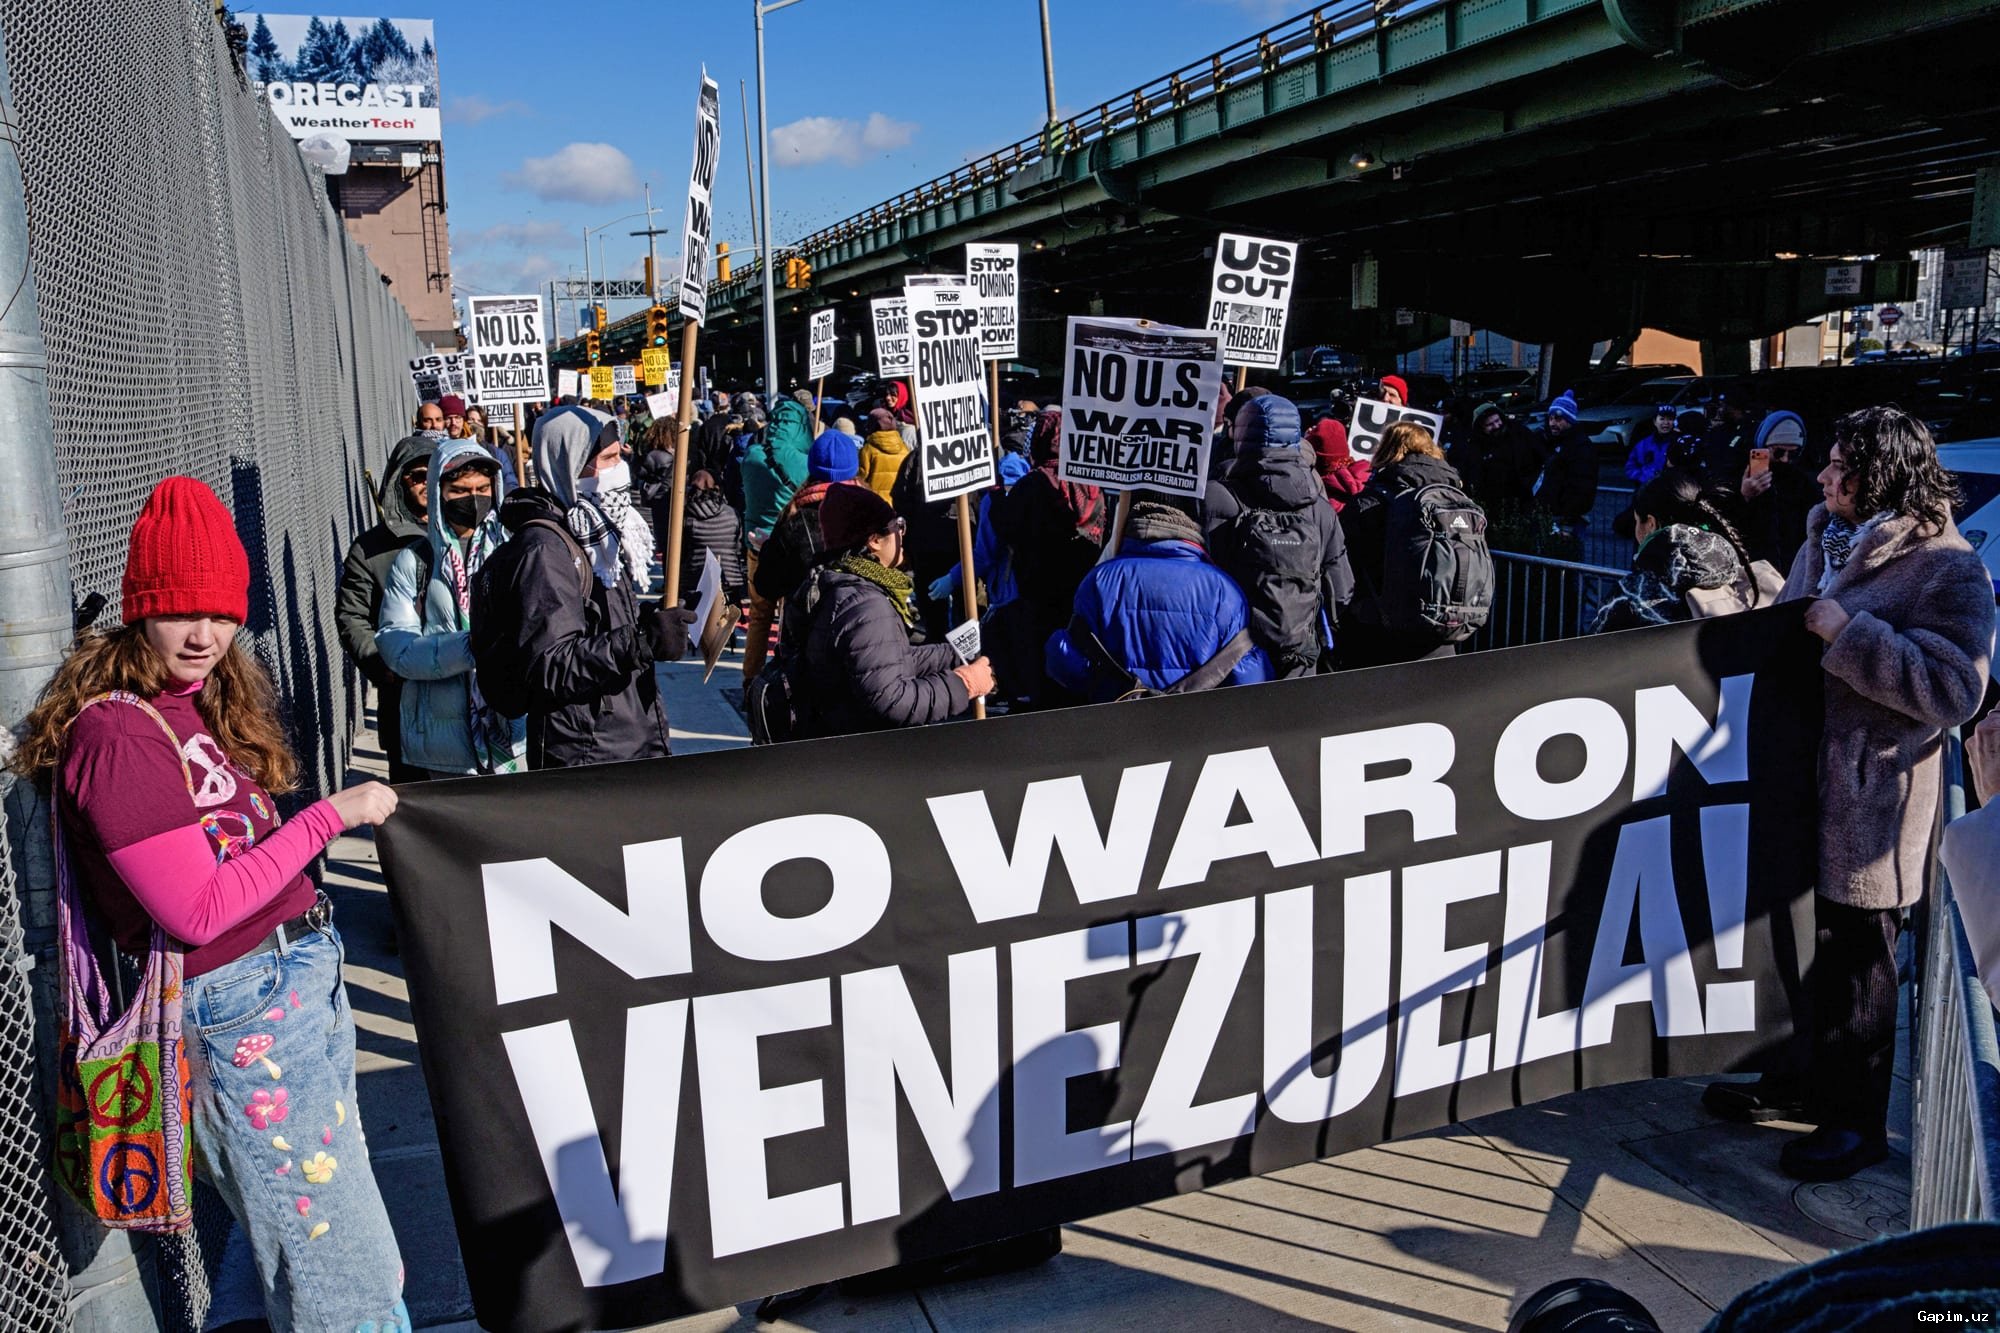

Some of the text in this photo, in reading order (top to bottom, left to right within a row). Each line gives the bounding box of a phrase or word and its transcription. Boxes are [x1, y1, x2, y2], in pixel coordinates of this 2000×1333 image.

[254, 81, 425, 107] ORECAST
[290, 117, 415, 129] WeatherTech
[693, 115, 714, 191] NO
[970, 257, 1015, 272] STOP
[1222, 238, 1291, 276] US
[936, 293, 960, 303] TRUMP
[1217, 273, 1289, 300] OUT
[818, 314, 831, 325] NO
[875, 306, 908, 318] STO
[915, 308, 979, 338] STOP
[980, 306, 1015, 327] ENEZUELA
[1212, 300, 1284, 327] OF THE
[475, 314, 541, 347] NO U.S.
[812, 347, 825, 367] FOR
[879, 338, 909, 355] VENEZ
[410, 356, 442, 371] US
[479, 352, 543, 368] WAR
[644, 356, 655, 367] NO
[881, 355, 910, 366] NO
[918, 337, 982, 388] BOMBING
[480, 368, 544, 389] VENEZUELA
[1072, 348, 1208, 411] NO U.S.
[921, 394, 986, 440] VENEZUELA
[1070, 408, 1204, 446] WAR
[926, 433, 989, 471] NOW!
[1122, 435, 1147, 445] ON
[1068, 433, 1199, 476] VENEZUELA
[1067, 465, 1195, 489] PARTY FOR SOCIALISM & LIBERATION
[480, 673, 1755, 1005] NO WAR ON
[501, 803, 1756, 1288] VENEZUELA!
